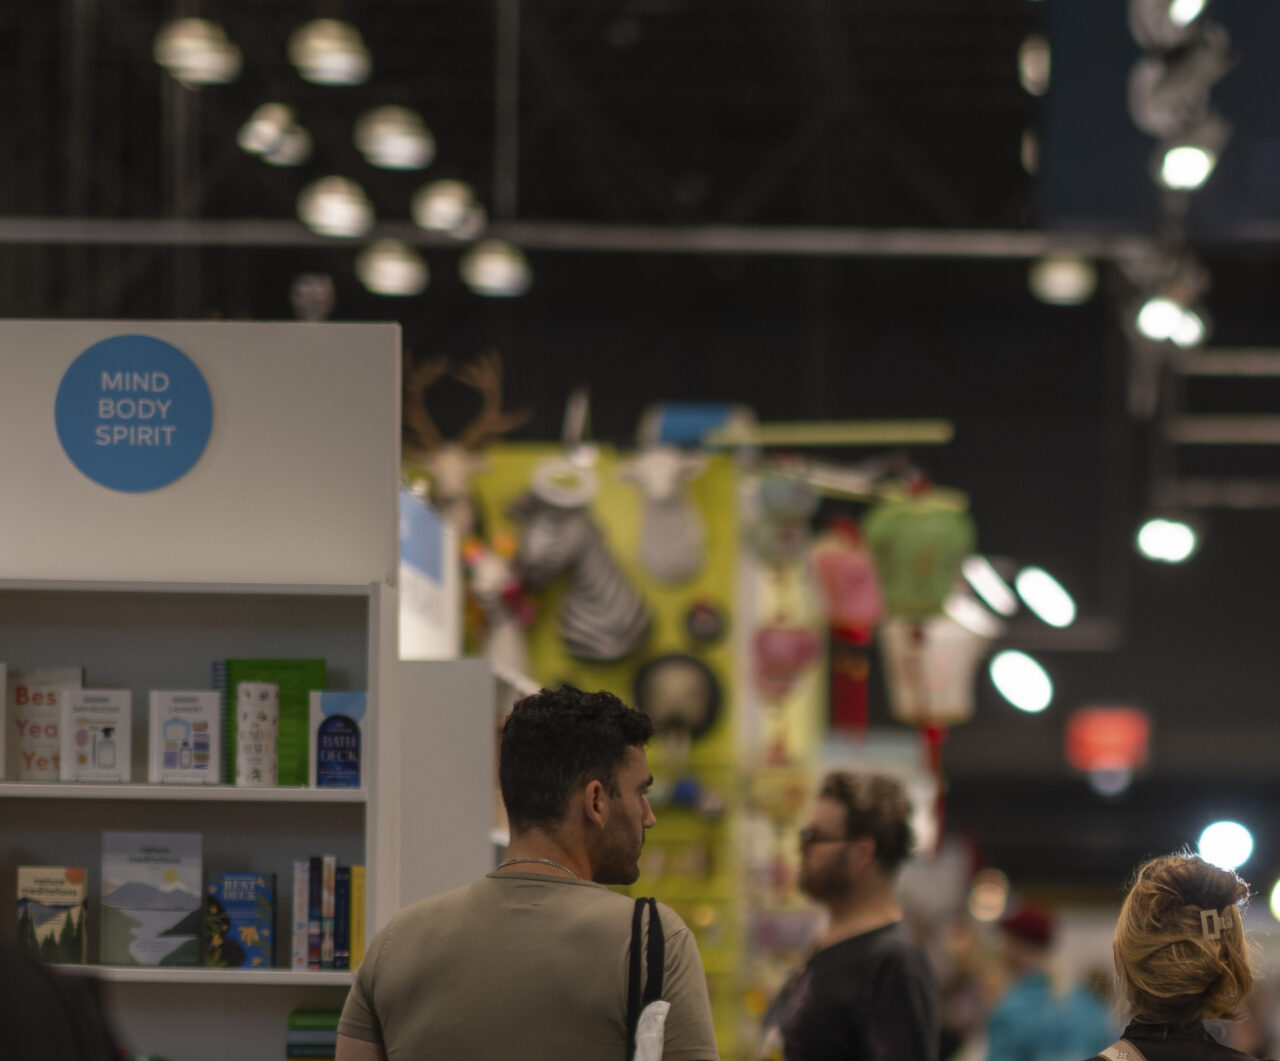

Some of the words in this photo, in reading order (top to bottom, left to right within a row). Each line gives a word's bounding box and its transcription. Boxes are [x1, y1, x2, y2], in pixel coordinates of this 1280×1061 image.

[101, 372, 170, 392] MIND
[98, 399, 173, 420] BODY
[95, 425, 177, 446] SPIRIT
[15, 685, 59, 707] Bes
[15, 718, 59, 740] Yea
